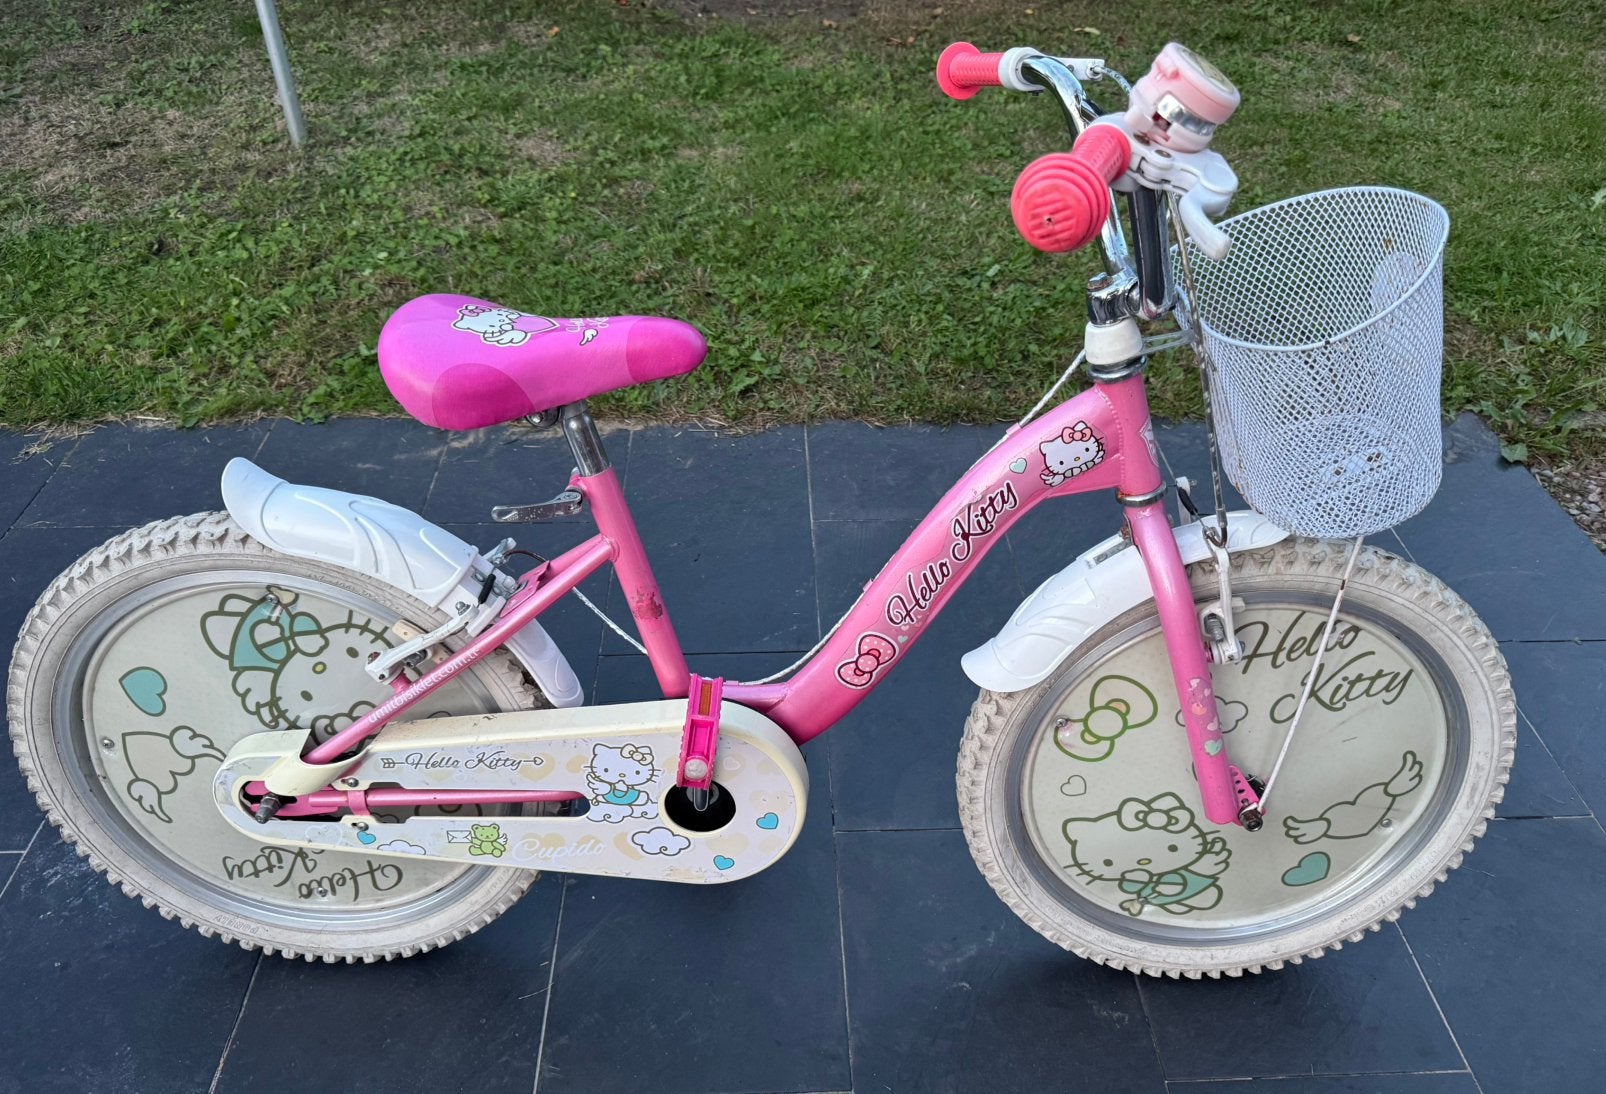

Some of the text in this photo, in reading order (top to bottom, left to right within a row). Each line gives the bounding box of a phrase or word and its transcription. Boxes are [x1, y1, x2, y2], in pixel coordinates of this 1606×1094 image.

[887, 481, 1017, 625] Hello Kitty
[1234, 611, 1363, 675] Hello
[1270, 650, 1414, 723] Kitty
[405, 751, 523, 771] Hello Kitty
[222, 845, 325, 887] Kitty
[511, 838, 607, 862] Cupido
[299, 859, 403, 902] Hello
